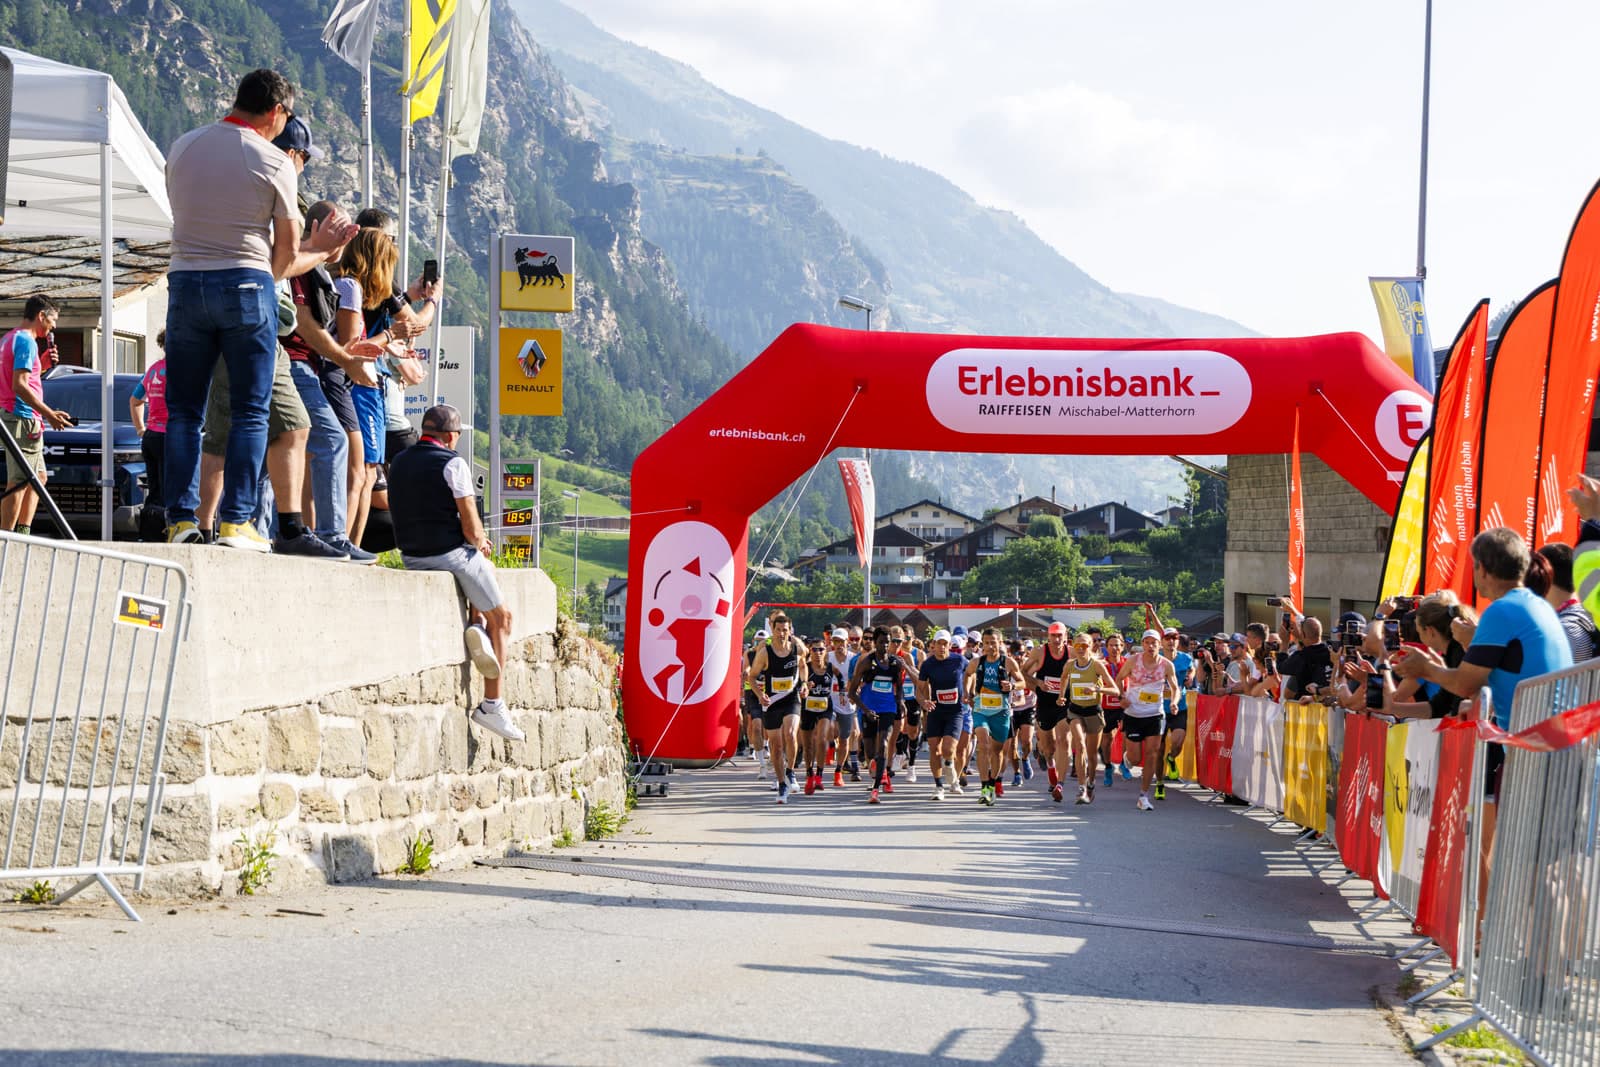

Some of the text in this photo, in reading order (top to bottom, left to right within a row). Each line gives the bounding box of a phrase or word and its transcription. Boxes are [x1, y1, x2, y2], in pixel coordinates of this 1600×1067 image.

[506, 384, 555, 393] RENAULT
[978, 403, 1196, 417] RAIFFEISEN Mischabel-Matterhorn
[709, 427, 806, 442] erlebnisbank.ch
[1460, 441, 1476, 510] gotthard bahn
[1453, 485, 1467, 541] matterhorn
